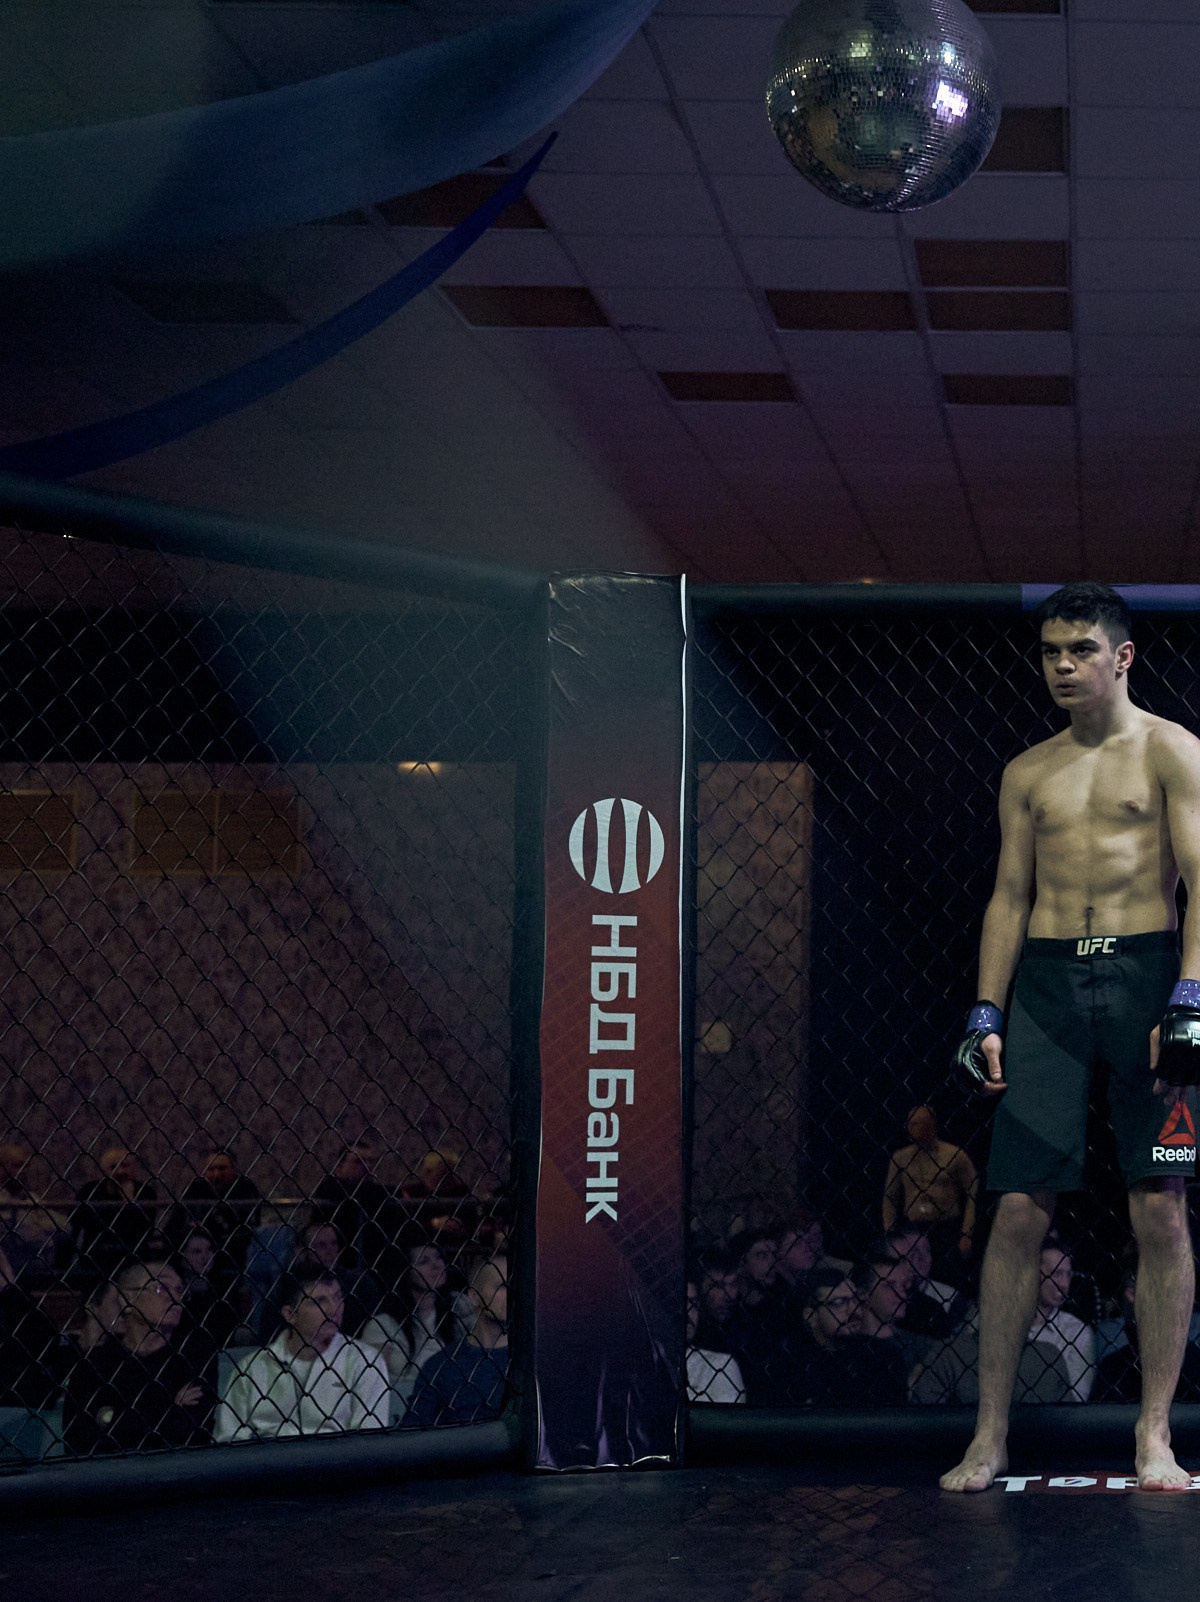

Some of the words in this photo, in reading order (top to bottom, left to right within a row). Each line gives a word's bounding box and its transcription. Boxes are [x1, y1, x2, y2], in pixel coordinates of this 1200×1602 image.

[589, 914, 638, 1055] НБД
[1076, 937, 1117, 956] UFC
[585, 1068, 635, 1224] Банк
